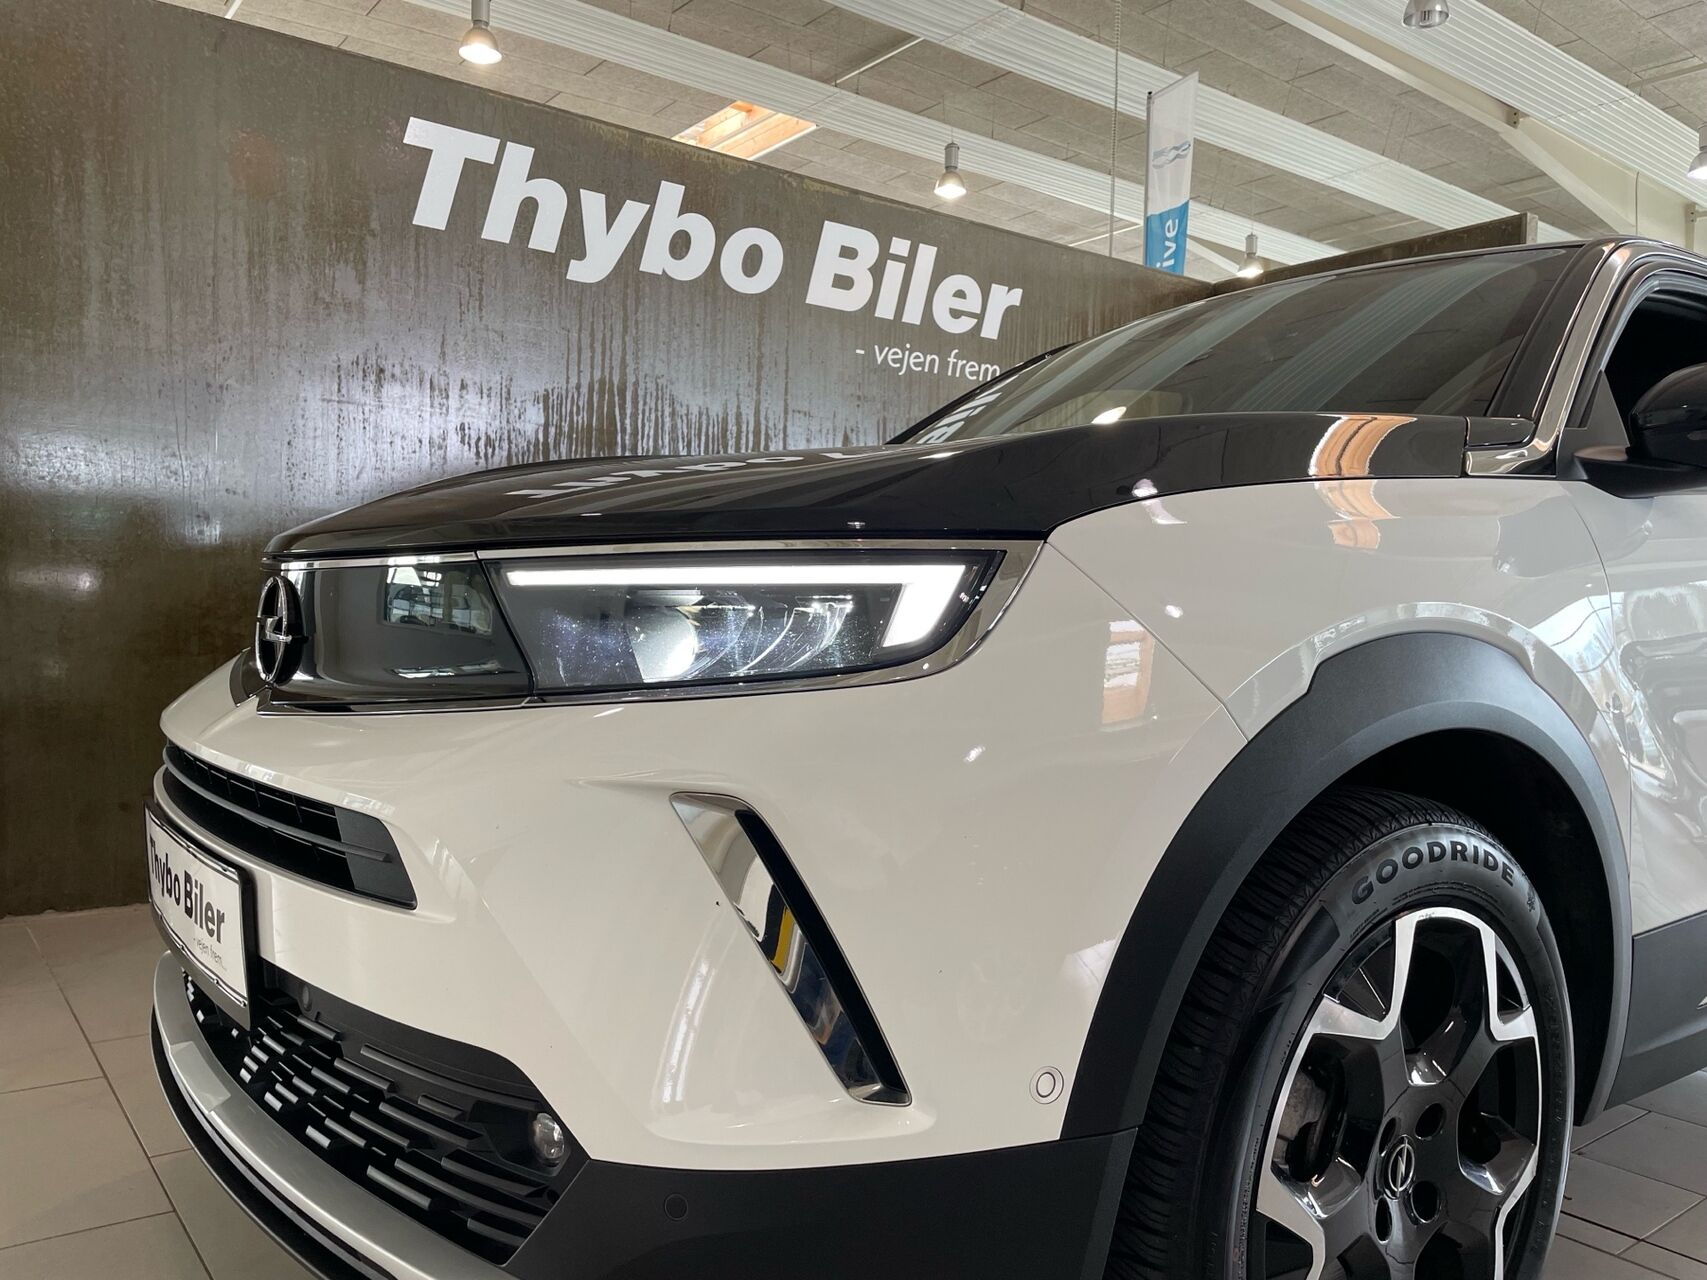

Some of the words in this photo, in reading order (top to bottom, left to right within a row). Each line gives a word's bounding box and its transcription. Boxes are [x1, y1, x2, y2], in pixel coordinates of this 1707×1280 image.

[403, 116, 784, 294] Thybo
[805, 220, 1023, 340] Biler
[874, 343, 940, 376] vejen
[150, 834, 181, 906] Thybo
[184, 869, 225, 944] Biler
[1351, 840, 1515, 905] GOODRIDE
